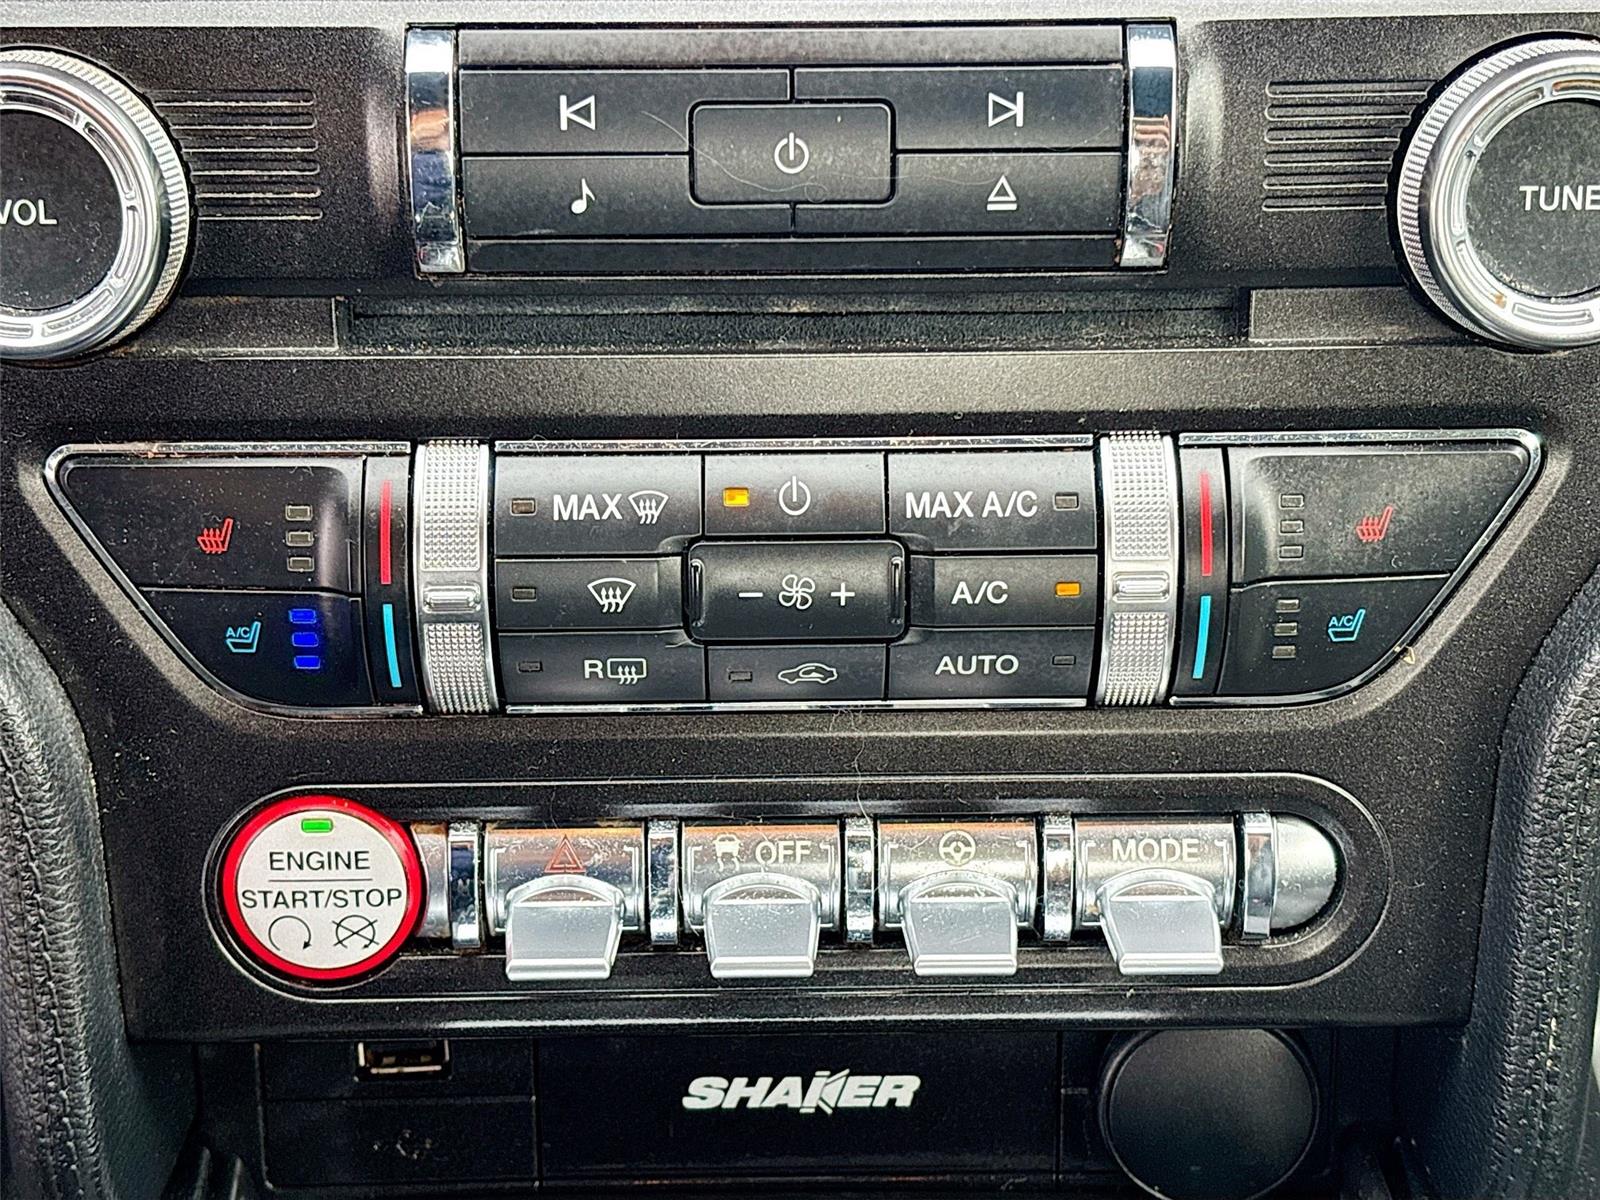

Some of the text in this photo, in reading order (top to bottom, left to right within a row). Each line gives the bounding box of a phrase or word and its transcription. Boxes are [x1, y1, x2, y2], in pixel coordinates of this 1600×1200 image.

[1519, 185, 1600, 211] TUNE
[0, 198, 58, 226] VOL
[552, 493, 623, 521] MAX
[905, 490, 1038, 518] MAX A/C
[951, 581, 1008, 605] A/C
[226, 626, 250, 638] A/C
[1328, 615, 1354, 627] A/C
[583, 659, 603, 679] R
[935, 655, 1019, 675] AUTO
[269, 851, 371, 871] ENGINE
[755, 840, 811, 864] OFF
[1112, 837, 1200, 861] MODE
[241, 888, 403, 909] START/STOP
[682, 1068, 921, 1115] SHAKER
